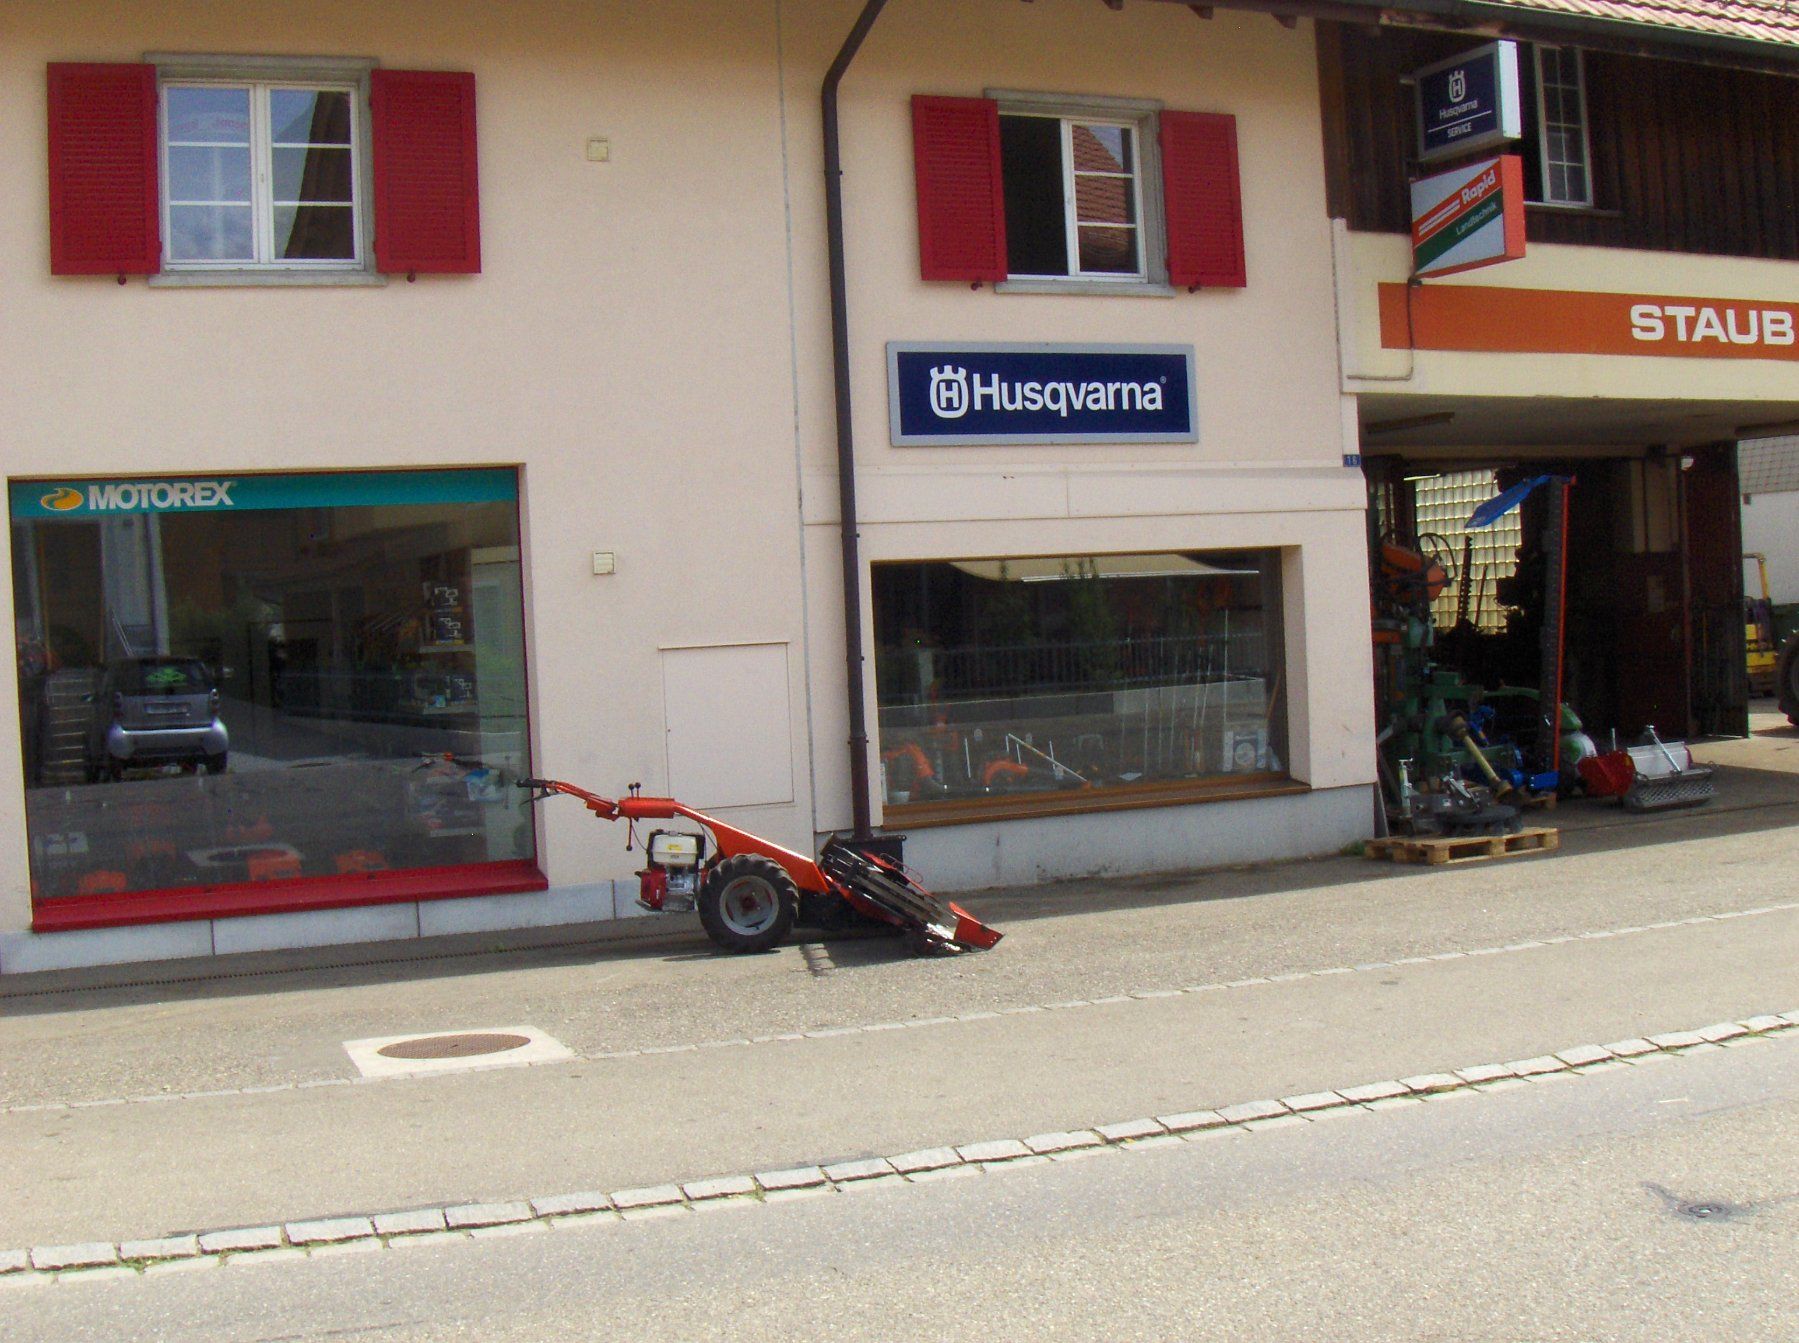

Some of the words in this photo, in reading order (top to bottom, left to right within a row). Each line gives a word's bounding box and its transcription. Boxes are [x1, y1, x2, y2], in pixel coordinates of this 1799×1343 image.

[1440, 100, 1478, 119] Husqvarna
[1447, 122, 1472, 138] SERVICE
[1462, 169, 1496, 204] Rapid
[1456, 201, 1497, 235] Landtechnik
[1630, 304, 1795, 345] STAUB
[973, 373, 1163, 417] Husqvarna
[88, 481, 234, 510] MOTOREX
